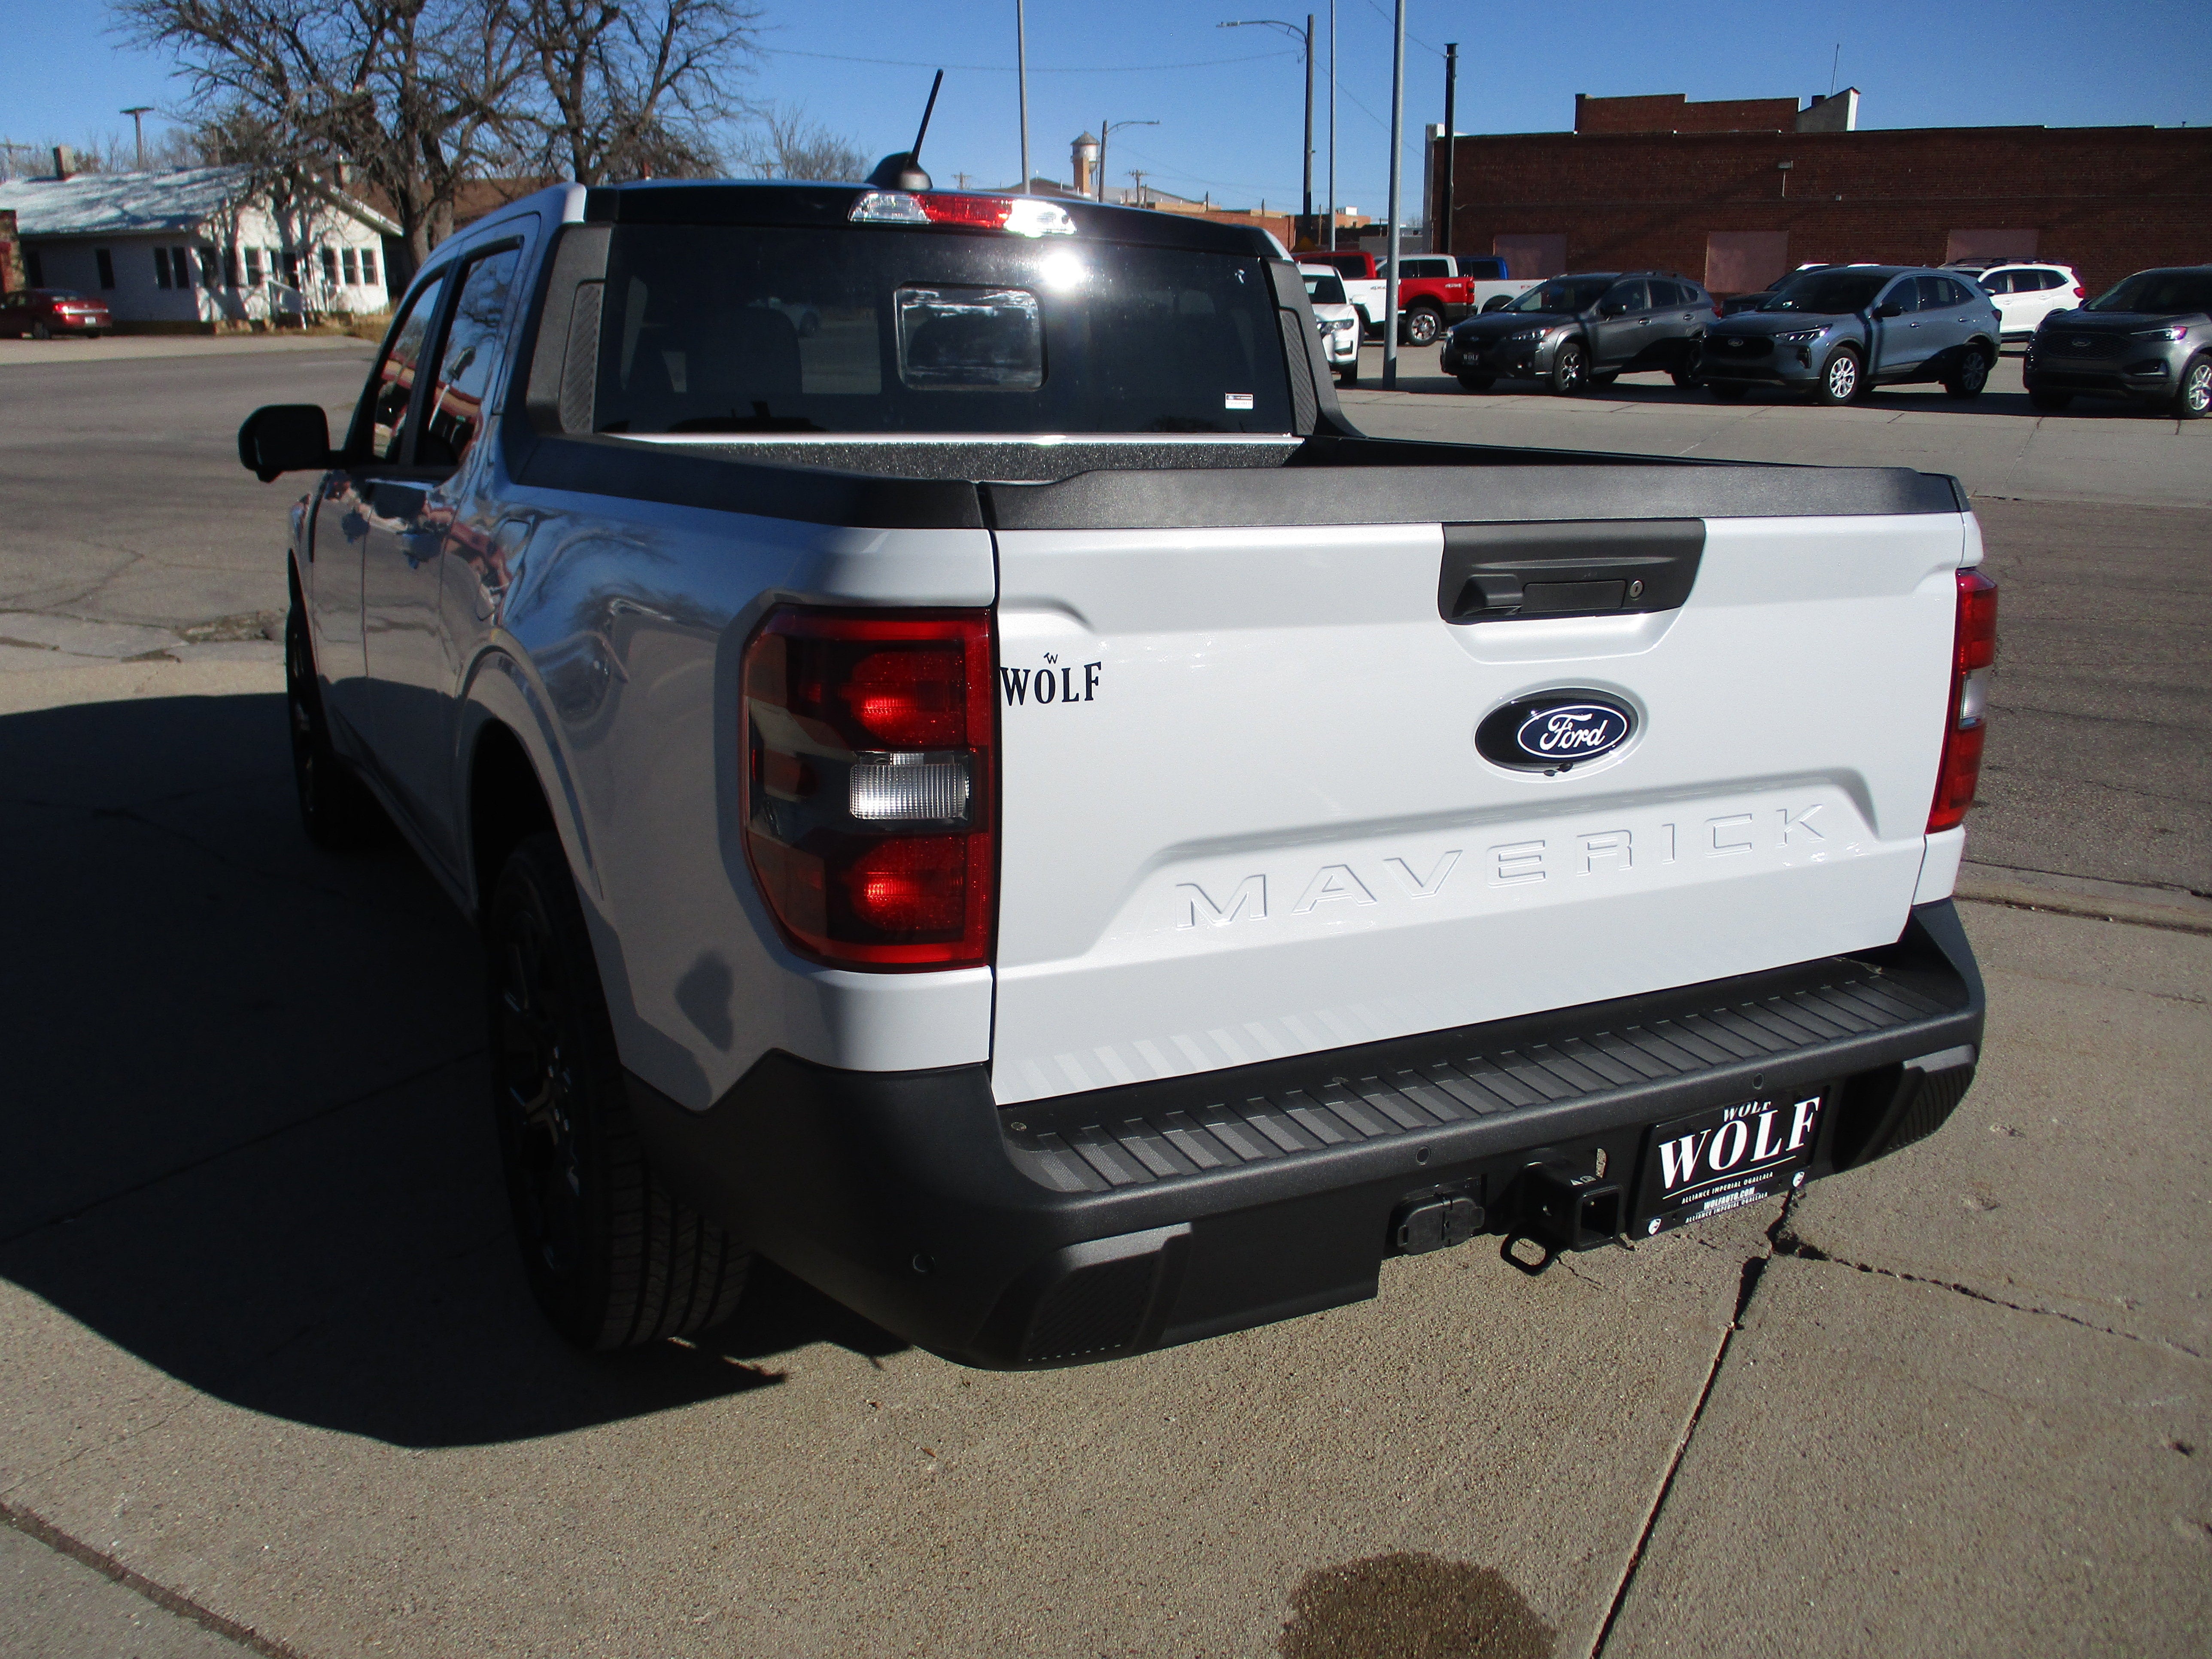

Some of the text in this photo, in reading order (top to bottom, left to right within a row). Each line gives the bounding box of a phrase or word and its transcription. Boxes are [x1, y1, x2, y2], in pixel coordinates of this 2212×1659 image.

[1000, 661, 1101, 706] WOLF
[1539, 713, 1608, 751] Ford
[1176, 803, 1826, 932] MAVERICK
[1723, 1101, 1771, 1122] WOLF
[1658, 1097, 1820, 1189] WOLF
[1681, 1171, 1773, 1205] ALLIANCE IMPERIAL OGALLALA
[1703, 1186, 1756, 1210] WOLFAUTO.COM
[1685, 1191, 1768, 1224] ALLIANCE IMPERIAL OGALLALA
